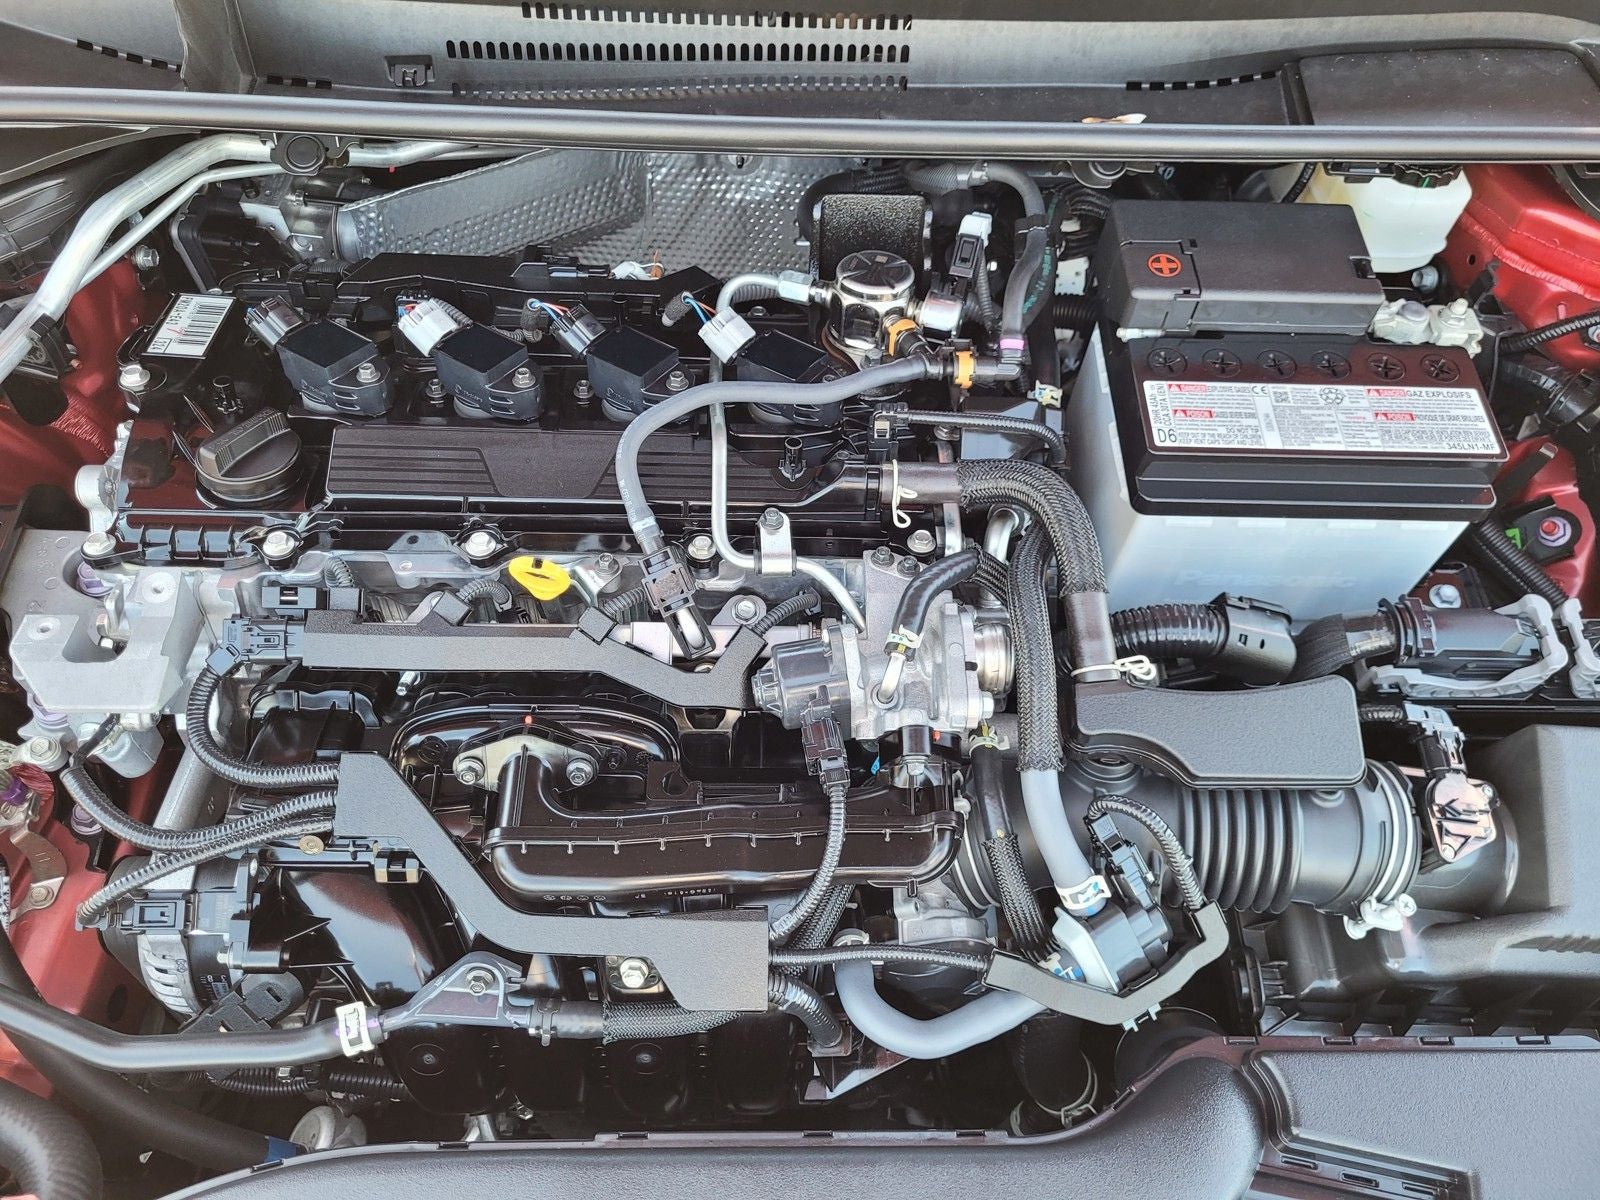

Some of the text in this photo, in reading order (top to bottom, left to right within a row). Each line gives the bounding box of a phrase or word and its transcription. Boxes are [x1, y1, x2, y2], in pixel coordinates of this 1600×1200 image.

[1407, 390, 1424, 398] GAZ
[1426, 391, 1472, 399] EXPLOSIFS
[1161, 413, 1173, 427] CCA
[1157, 428, 1178, 443] D6
[1445, 442, 1496, 451] 345LN1-MF
[1173, 570, 1360, 588] Panasonic
